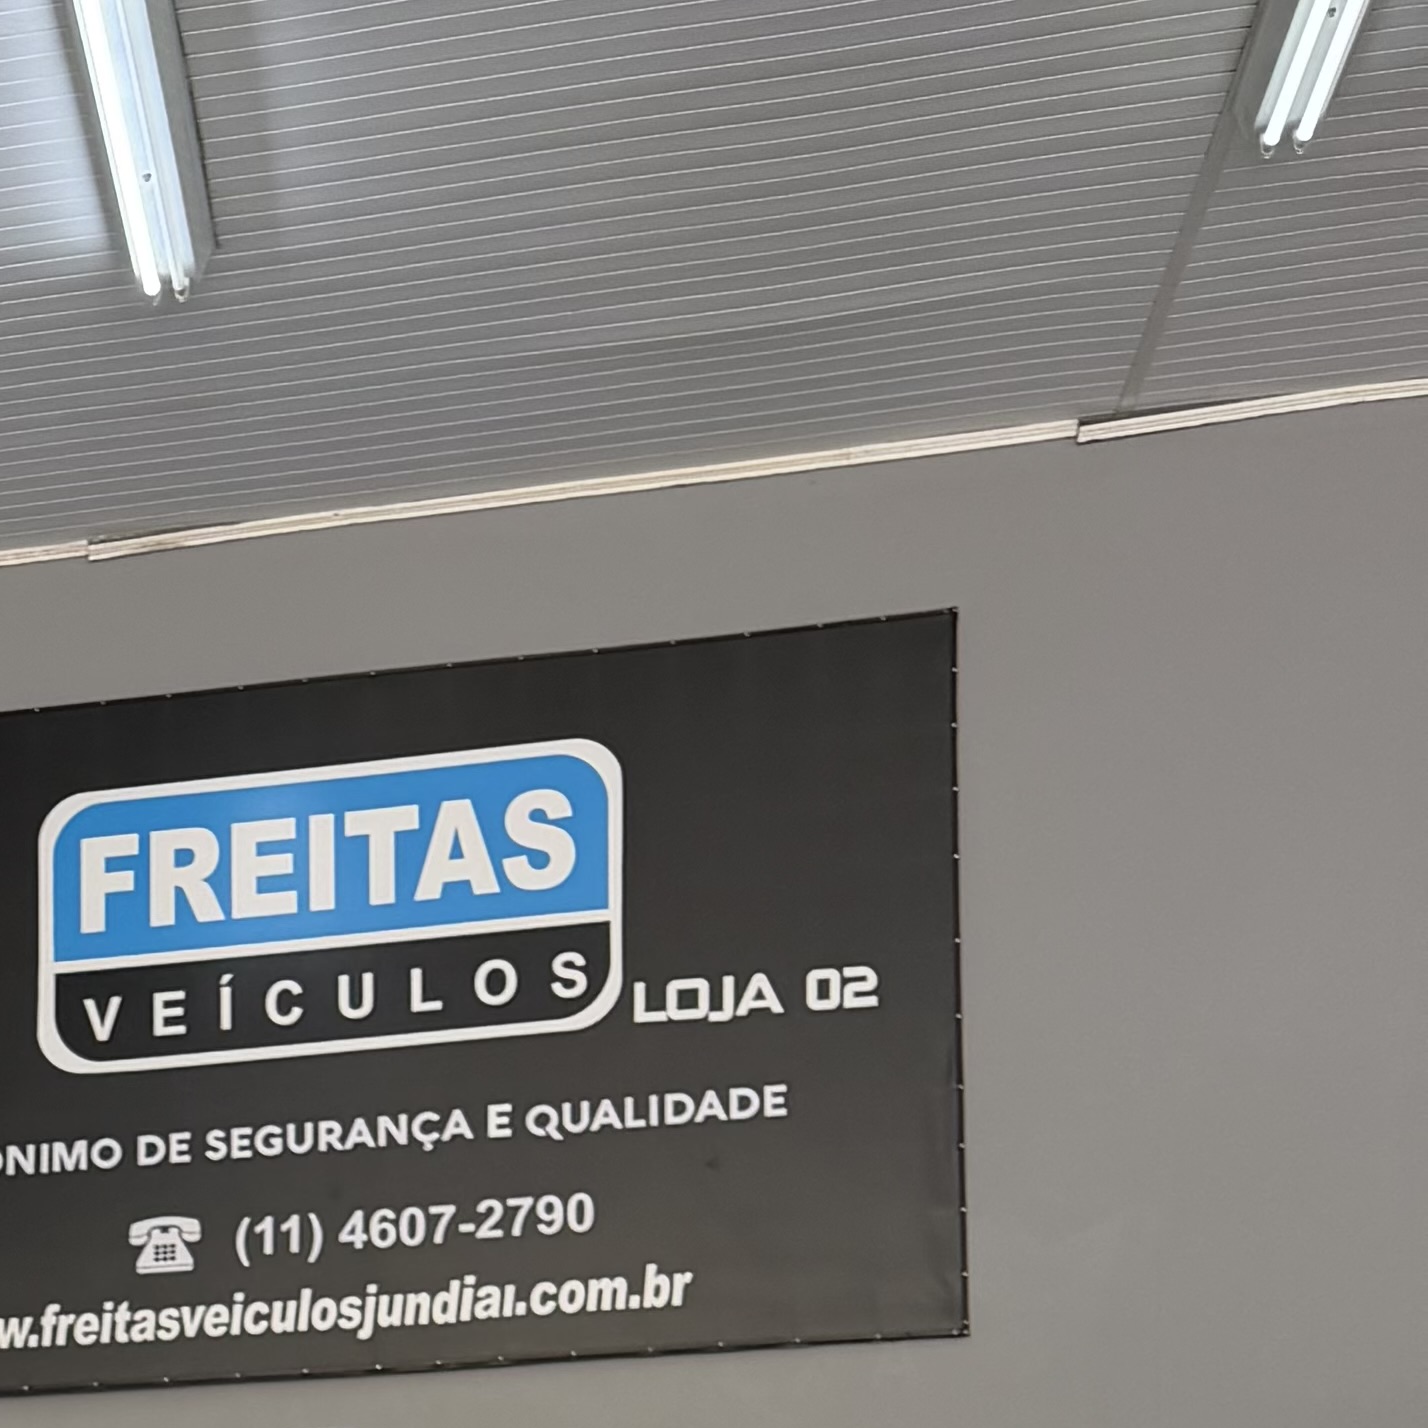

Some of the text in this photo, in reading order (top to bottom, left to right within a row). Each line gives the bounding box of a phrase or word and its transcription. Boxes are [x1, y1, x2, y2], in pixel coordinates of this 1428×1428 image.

[81, 789, 576, 933] FREITAS
[83, 951, 588, 1042] VEÍCULOS
[633, 965, 879, 1023] LOJA 02
[137, 1131, 192, 1166] DE
[204, 1108, 474, 1161] SEGURANÇA
[487, 1103, 513, 1139] E
[525, 1083, 788, 1141] QUALIDADE
[235, 1192, 595, 1267] (11) 4607-2790
